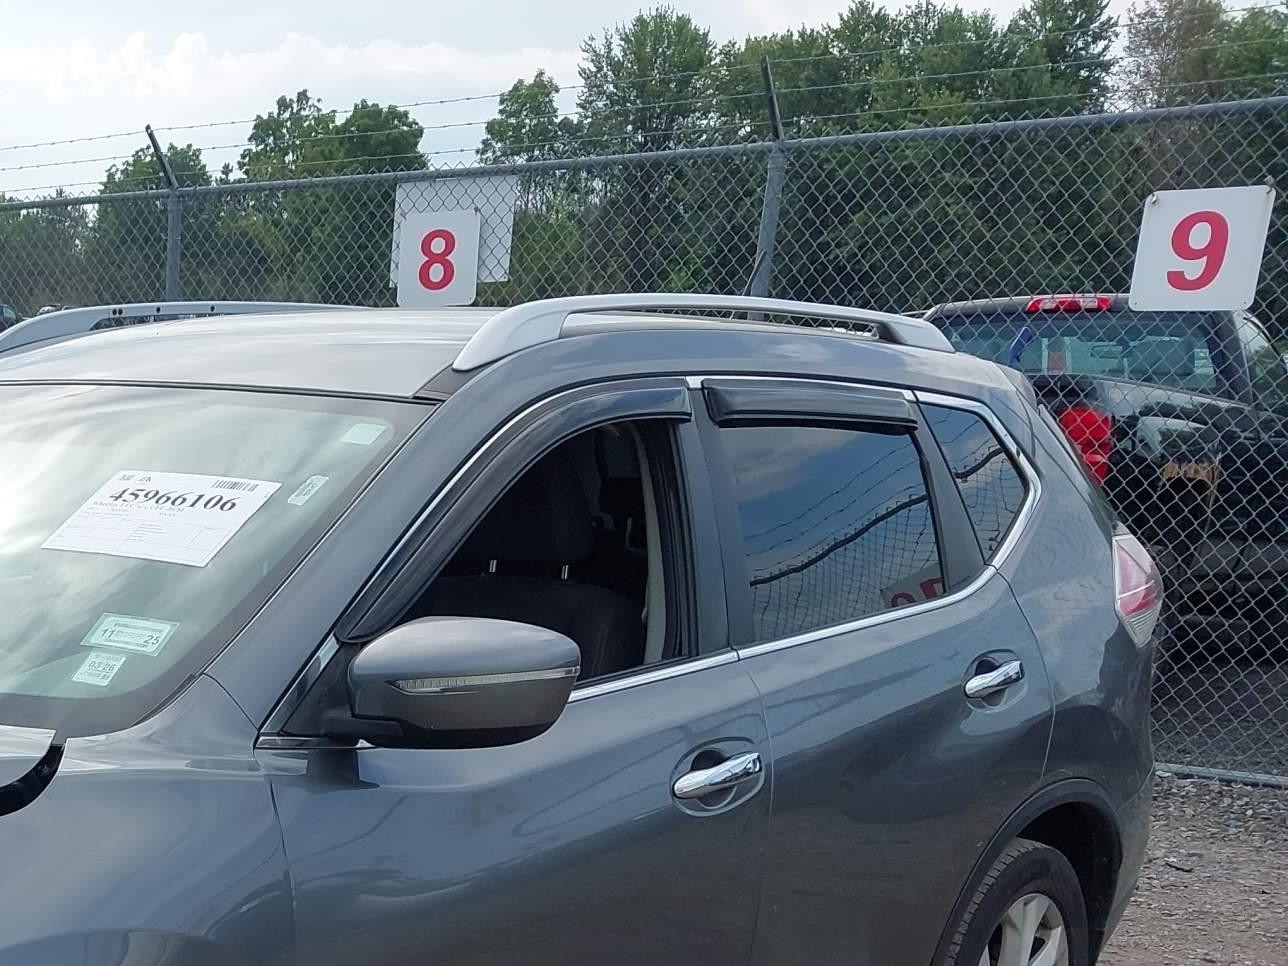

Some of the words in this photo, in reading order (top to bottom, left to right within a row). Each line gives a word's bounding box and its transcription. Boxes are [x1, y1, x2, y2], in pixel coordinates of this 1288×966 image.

[418, 229, 456, 291] 8
[1166, 210, 1229, 291] 9
[109, 487, 239, 511] 45966106
[143, 634, 160, 645] 25
